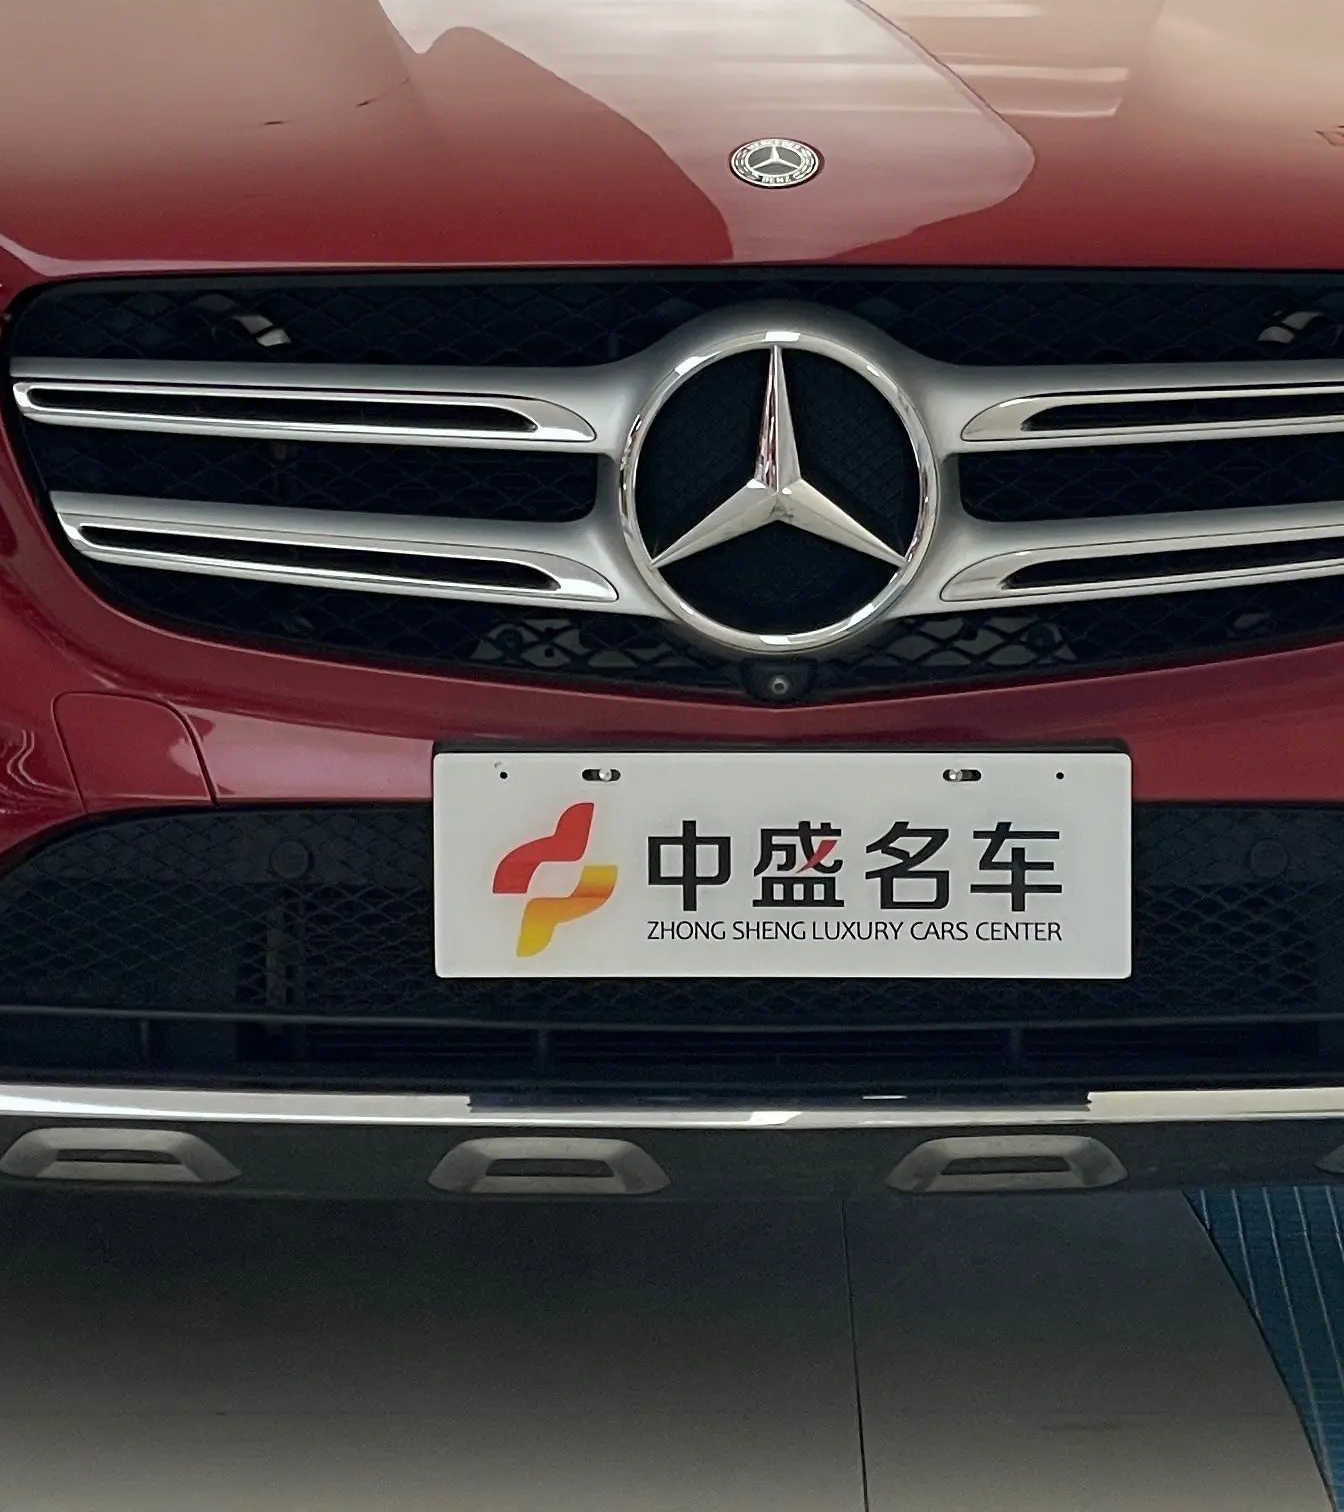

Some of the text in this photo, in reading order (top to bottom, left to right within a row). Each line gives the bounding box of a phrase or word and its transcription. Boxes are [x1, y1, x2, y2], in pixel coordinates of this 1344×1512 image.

[647, 819, 1063, 912] 中盛名车
[647, 920, 1063, 942] ZHONG SHENG LUXURY CARS CENTER
